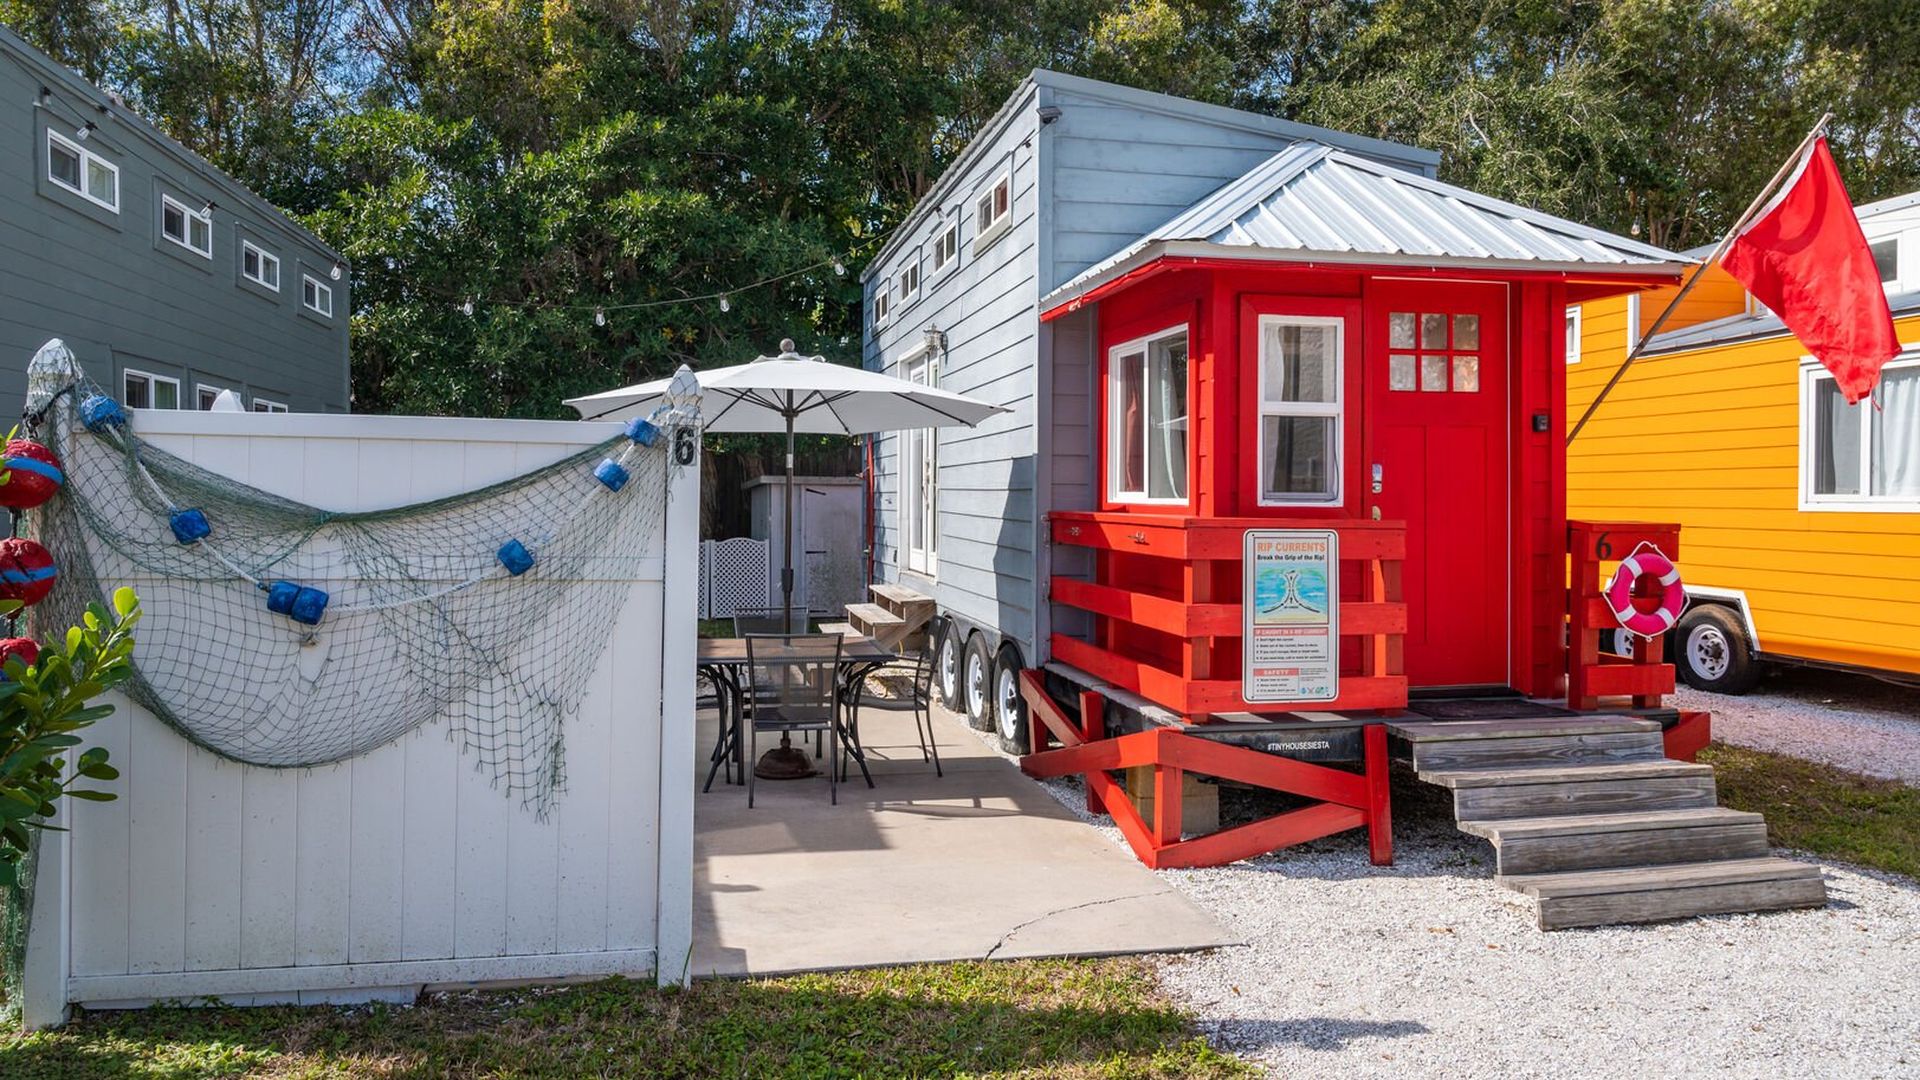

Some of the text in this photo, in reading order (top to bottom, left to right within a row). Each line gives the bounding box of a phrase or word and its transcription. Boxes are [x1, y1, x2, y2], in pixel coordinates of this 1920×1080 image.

[675, 426, 694, 465] 6
[1257, 542, 1326, 552] RIP CURRENTS
[1596, 531, 1612, 560] 6
[1267, 741, 1330, 751] #TINYHOUSESIESTA
